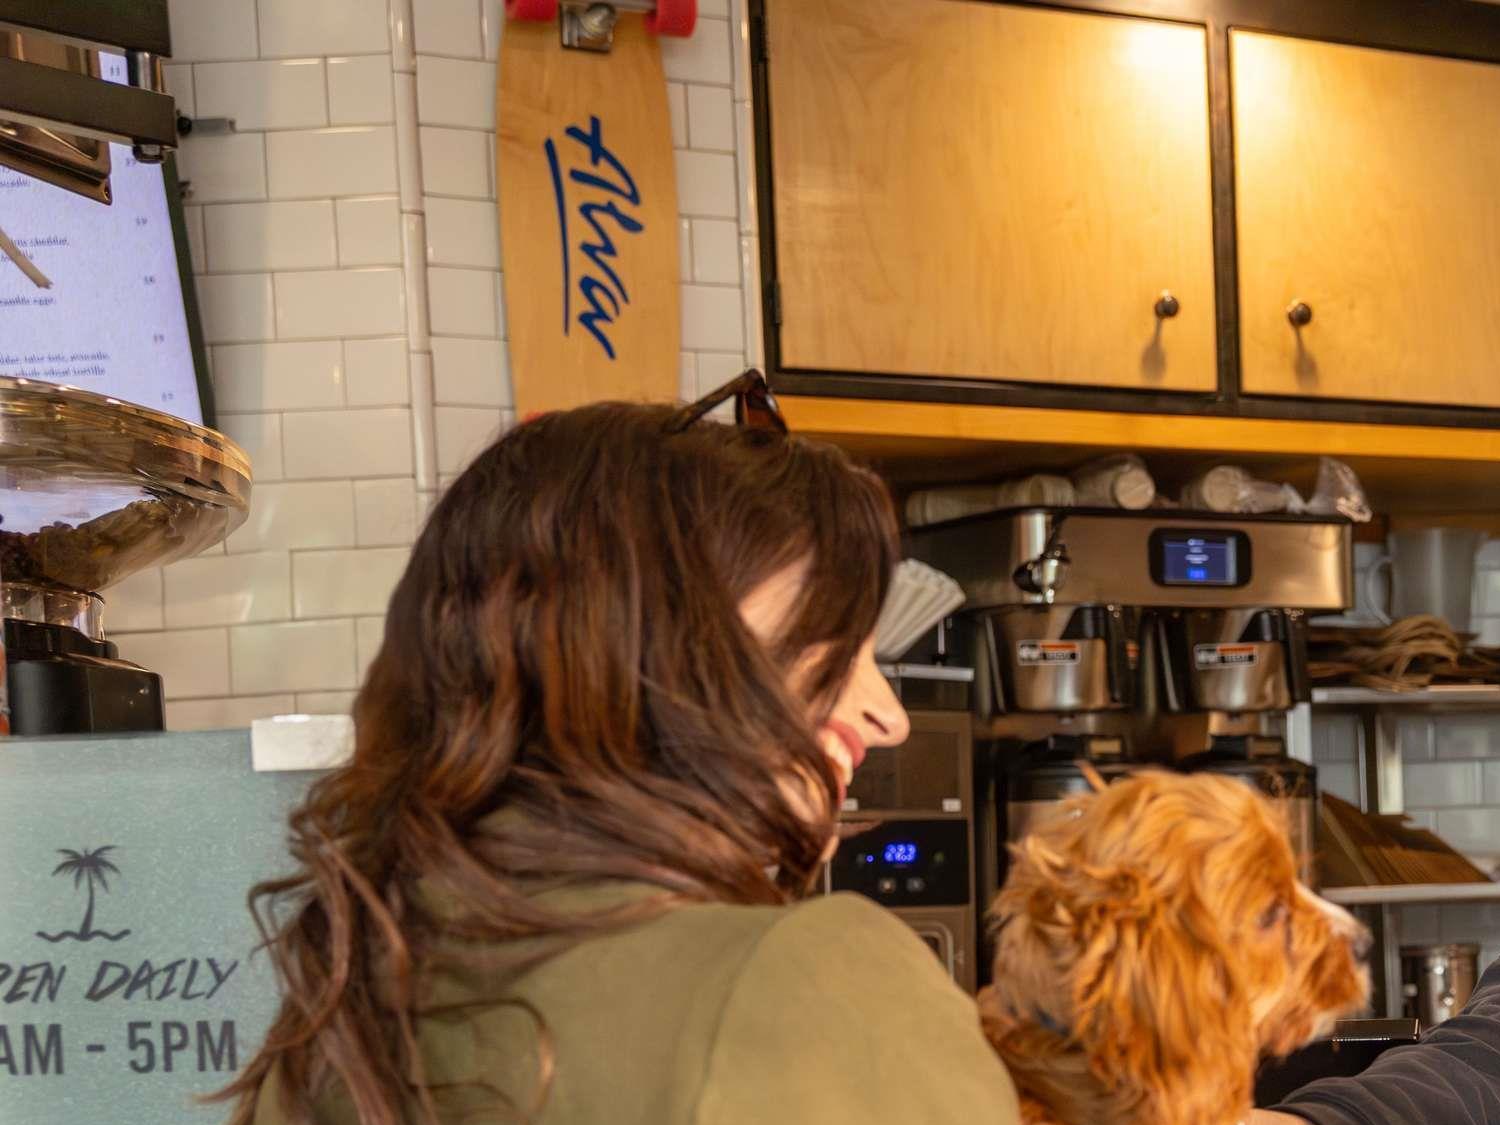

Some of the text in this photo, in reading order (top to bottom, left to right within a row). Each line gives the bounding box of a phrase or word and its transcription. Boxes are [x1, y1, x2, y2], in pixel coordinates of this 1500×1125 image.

[561, 113, 646, 361] Alva
[85, 957, 239, 1001] DAILY
[127, 1019, 238, 1075] 5PM
